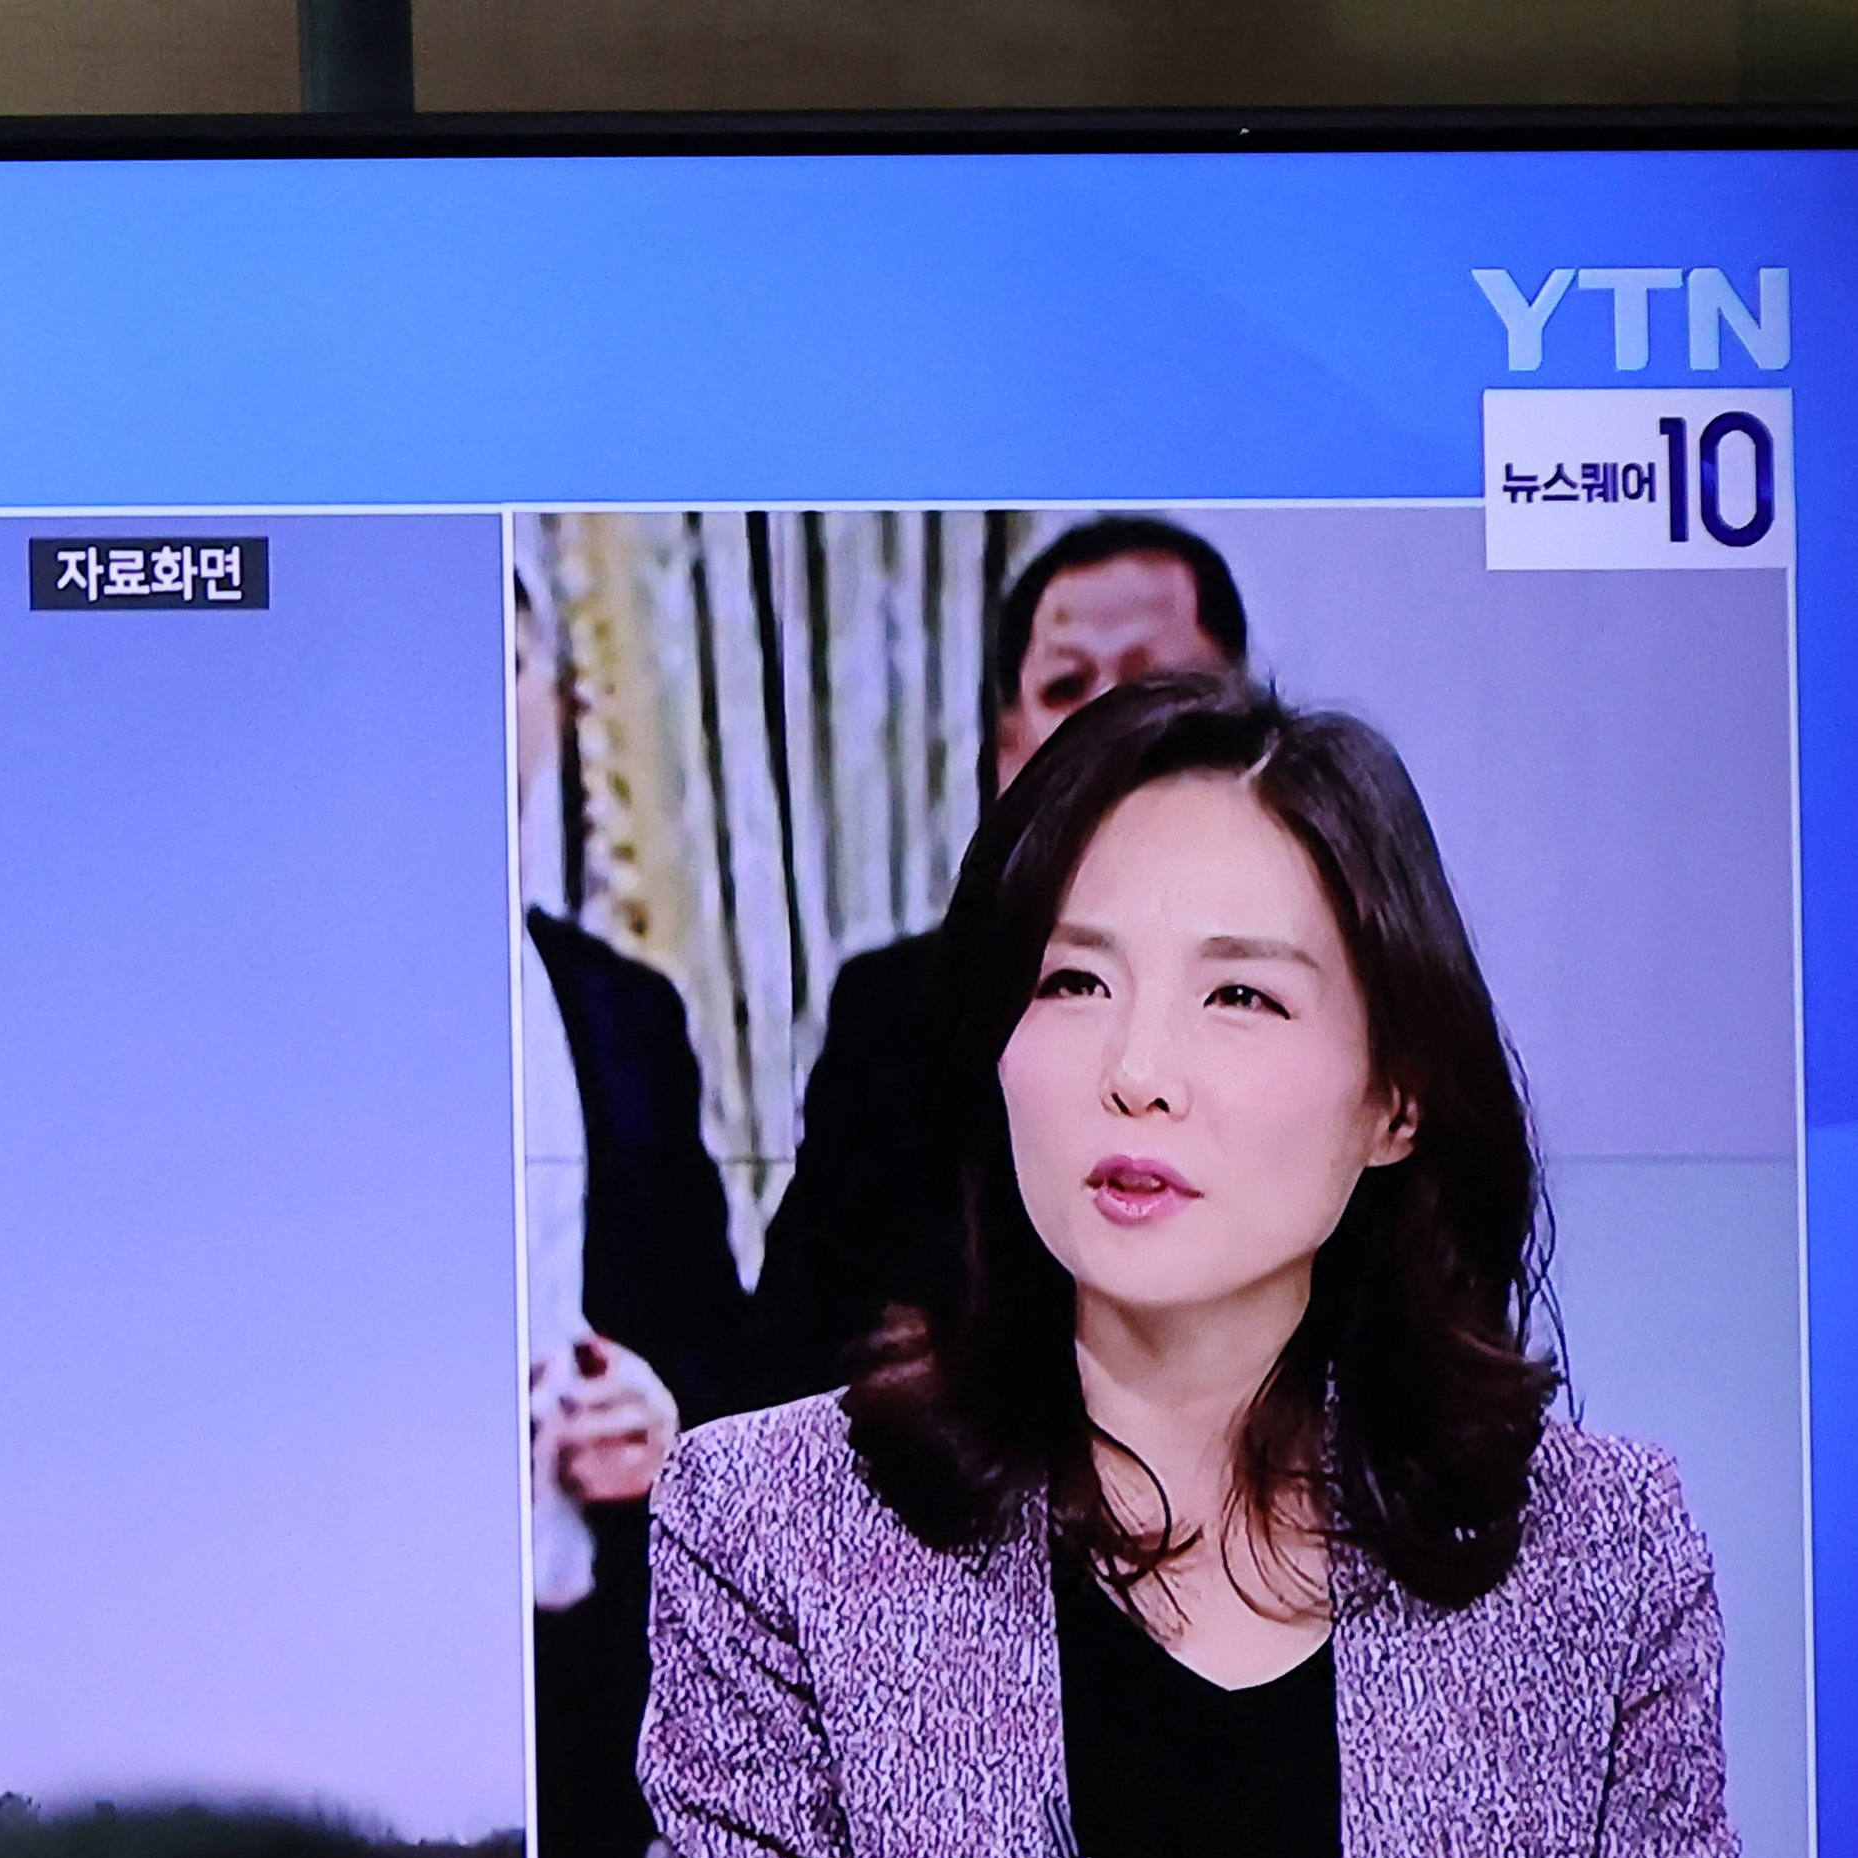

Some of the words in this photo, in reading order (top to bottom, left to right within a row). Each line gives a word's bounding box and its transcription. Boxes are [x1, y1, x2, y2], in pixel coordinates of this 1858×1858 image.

[1470, 267, 1791, 372] YTN
[1502, 462, 1657, 503] 뉴스퀘어
[1659, 410, 1776, 548] 10
[57, 545, 243, 602] 자료화면
